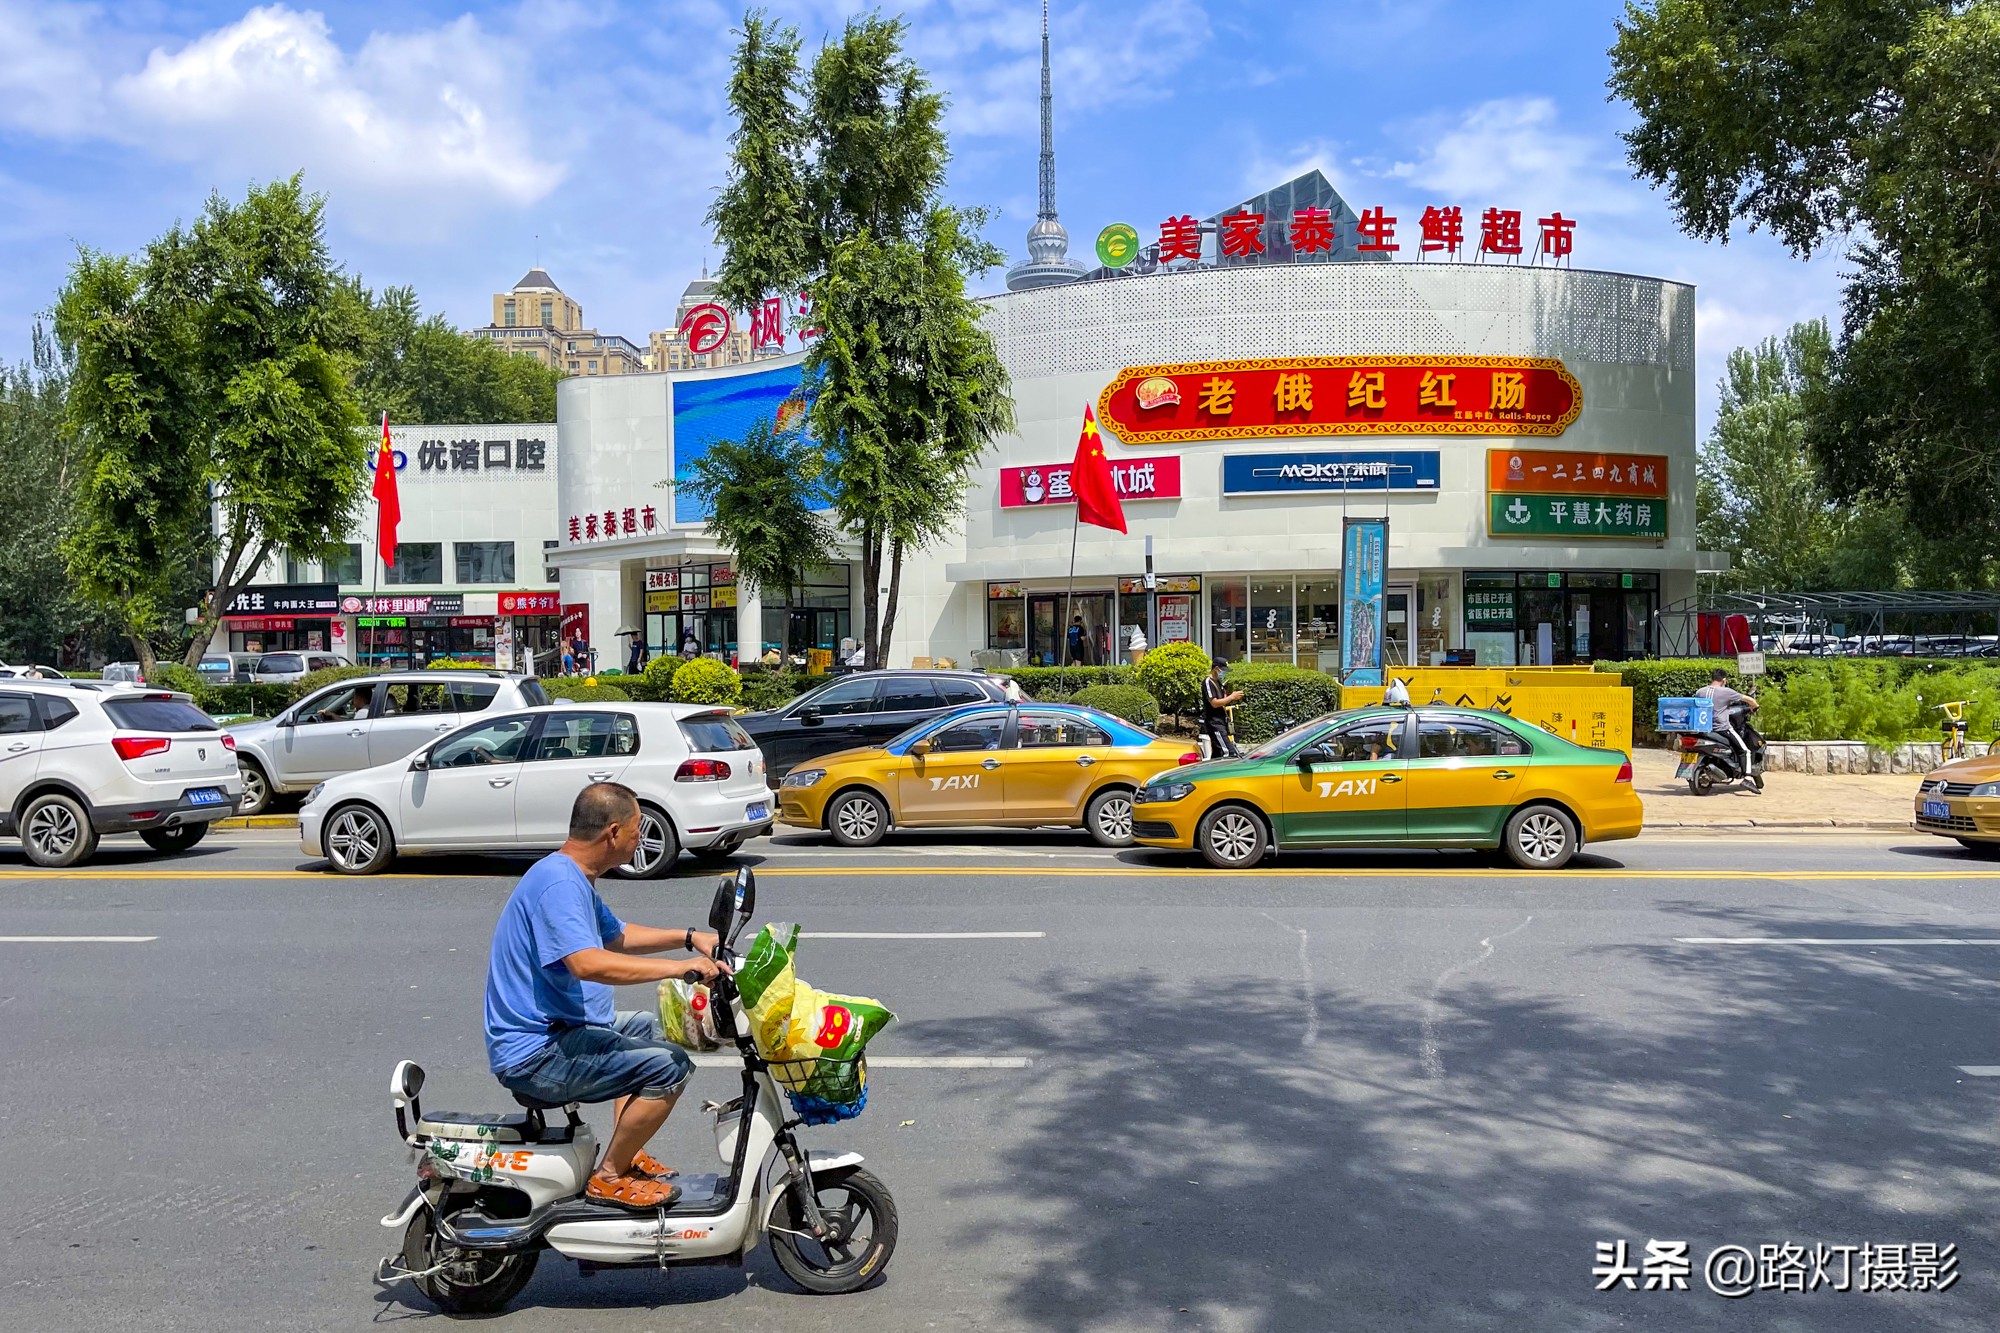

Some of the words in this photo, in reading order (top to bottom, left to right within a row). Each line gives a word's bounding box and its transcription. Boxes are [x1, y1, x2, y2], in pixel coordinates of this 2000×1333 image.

[1158, 205, 1577, 265] 美家泰生鲜超市
[1198, 370, 1527, 415] 老俄纪红肠
[1454, 411, 1493, 420] 红肠中的
[1499, 411, 1551, 422] Rolls-Royce
[417, 439, 546, 471] 优诺口腔
[1531, 462, 1658, 489] 一二三四九商城
[568, 503, 656, 543] 美家泰超市
[1549, 501, 1652, 527] 平慧大药房
[649, 572, 678, 588] 名烟名酒
[1467, 592, 1513, 604] 市医保已开通
[1160, 603, 1189, 620] 招聘
[1467, 607, 1514, 620] 省医保已开通
[929, 774, 980, 791] TAXI
[1317, 778, 1377, 798] TAXI
